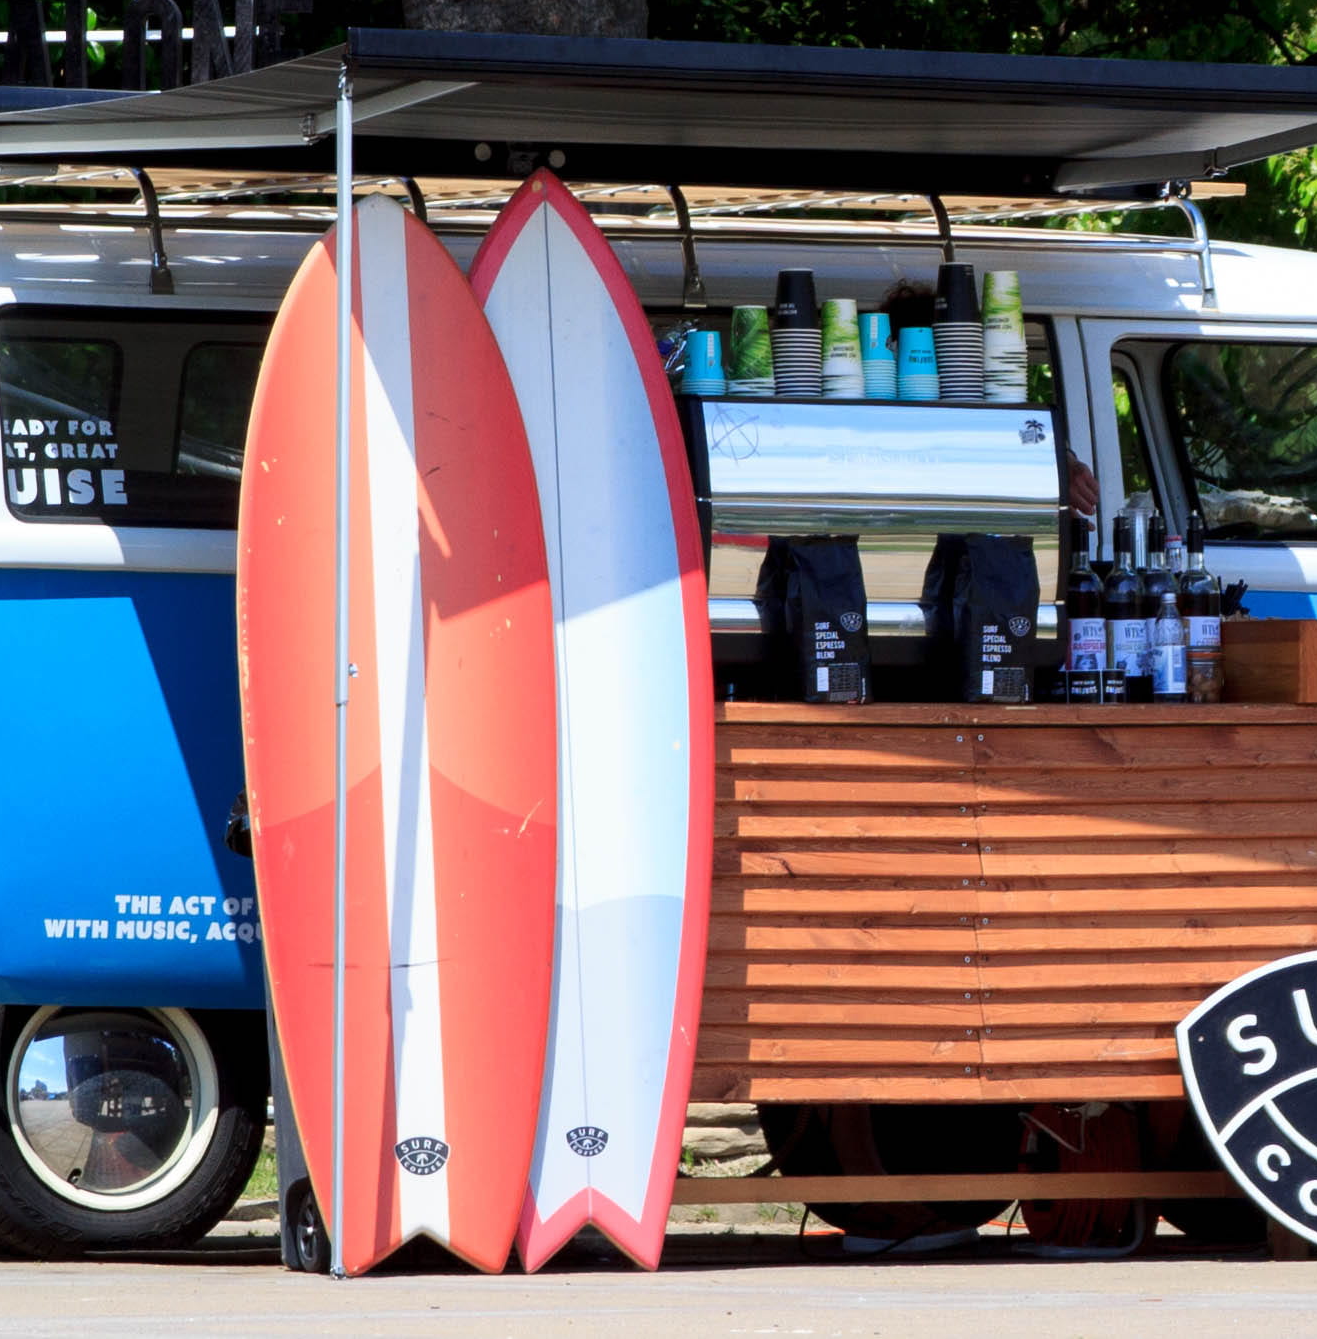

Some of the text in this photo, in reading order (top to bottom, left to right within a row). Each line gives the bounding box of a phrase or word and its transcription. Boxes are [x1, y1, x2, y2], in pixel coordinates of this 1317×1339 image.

[68, 419, 113, 436] FOR
[43, 442, 119, 460] GREAT
[815, 631, 839, 640] SPECIAL
[982, 634, 1007, 644] SPECIAL
[815, 640, 846, 650] ESPRESSO
[982, 644, 1012, 653] ESPRESSO
[815, 650, 836, 660] BLEND
[981, 654, 1002, 663] BLEND
[114, 894, 255, 917] THE ACT OF
[43, 918, 110, 940] WITH
[115, 919, 199, 944] MUSIC,
[569, 1127, 605, 1140] SURF
[400, 1138, 444, 1154] SURF
[571, 1143, 606, 1157] COFFEE
[402, 1159, 443, 1176] COFFEE
